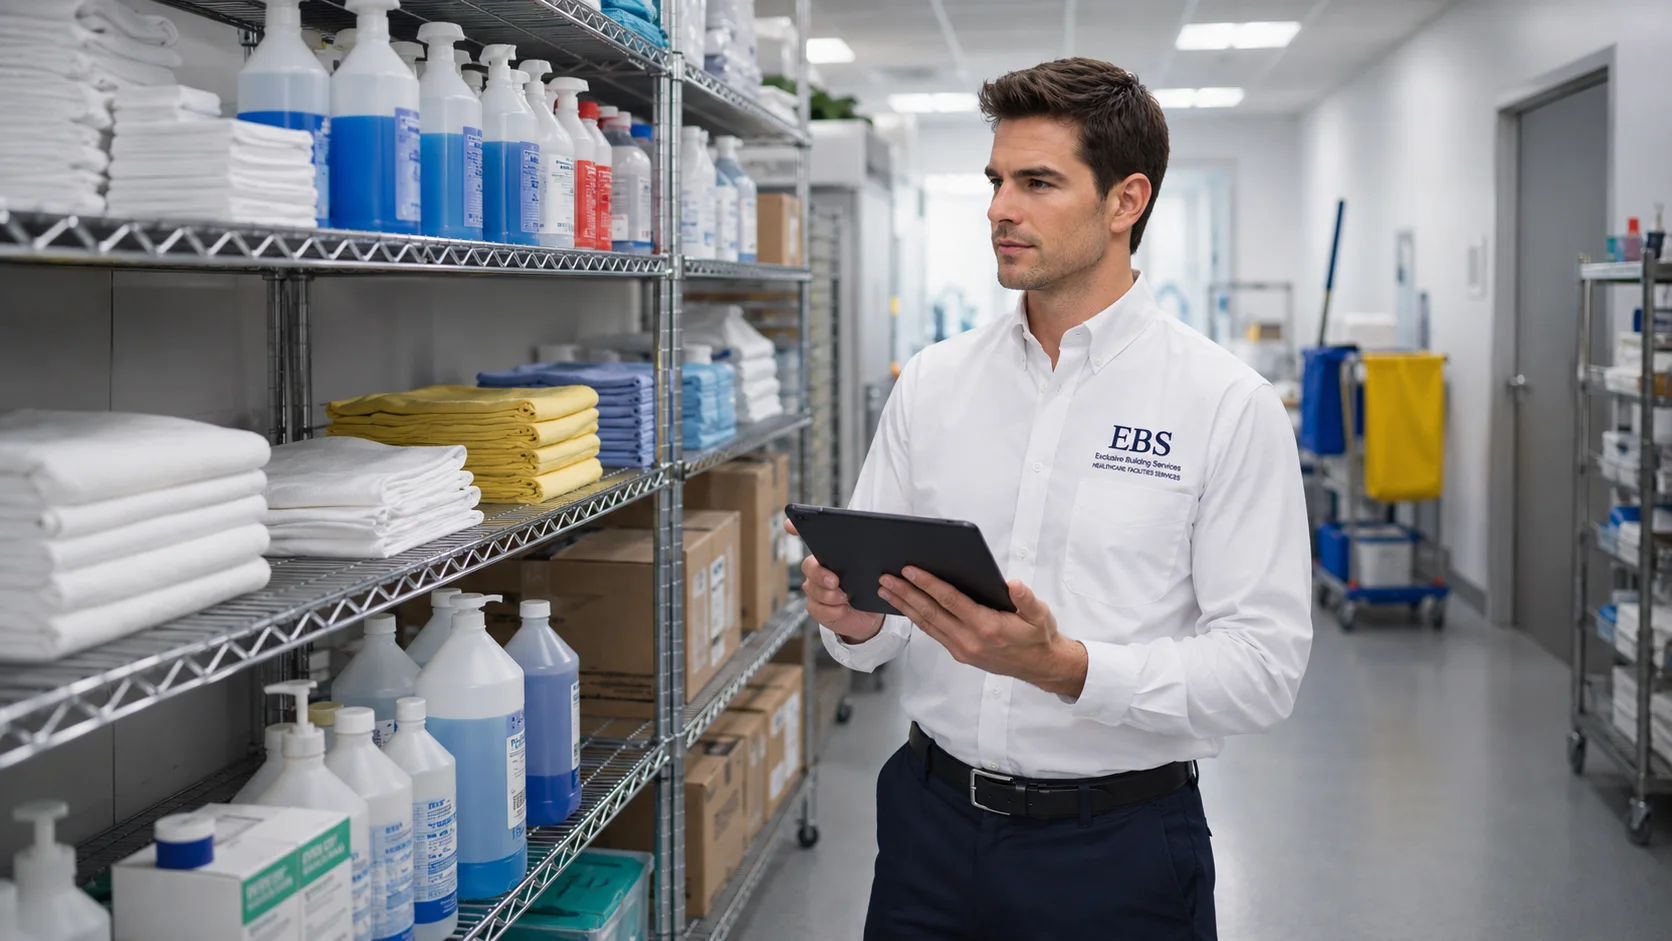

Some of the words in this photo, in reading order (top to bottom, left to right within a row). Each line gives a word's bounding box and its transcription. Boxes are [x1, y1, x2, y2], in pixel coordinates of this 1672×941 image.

[1108, 425, 1172, 456] EBS
[1095, 453, 1124, 462] Exclusive
[1125, 457, 1151, 468] Building
[1152, 460, 1181, 471] Services
[1092, 463, 1126, 472] HEALTHCARE
[1127, 466, 1153, 475] FACILITIES
[1155, 471, 1181, 481] SERVICES
